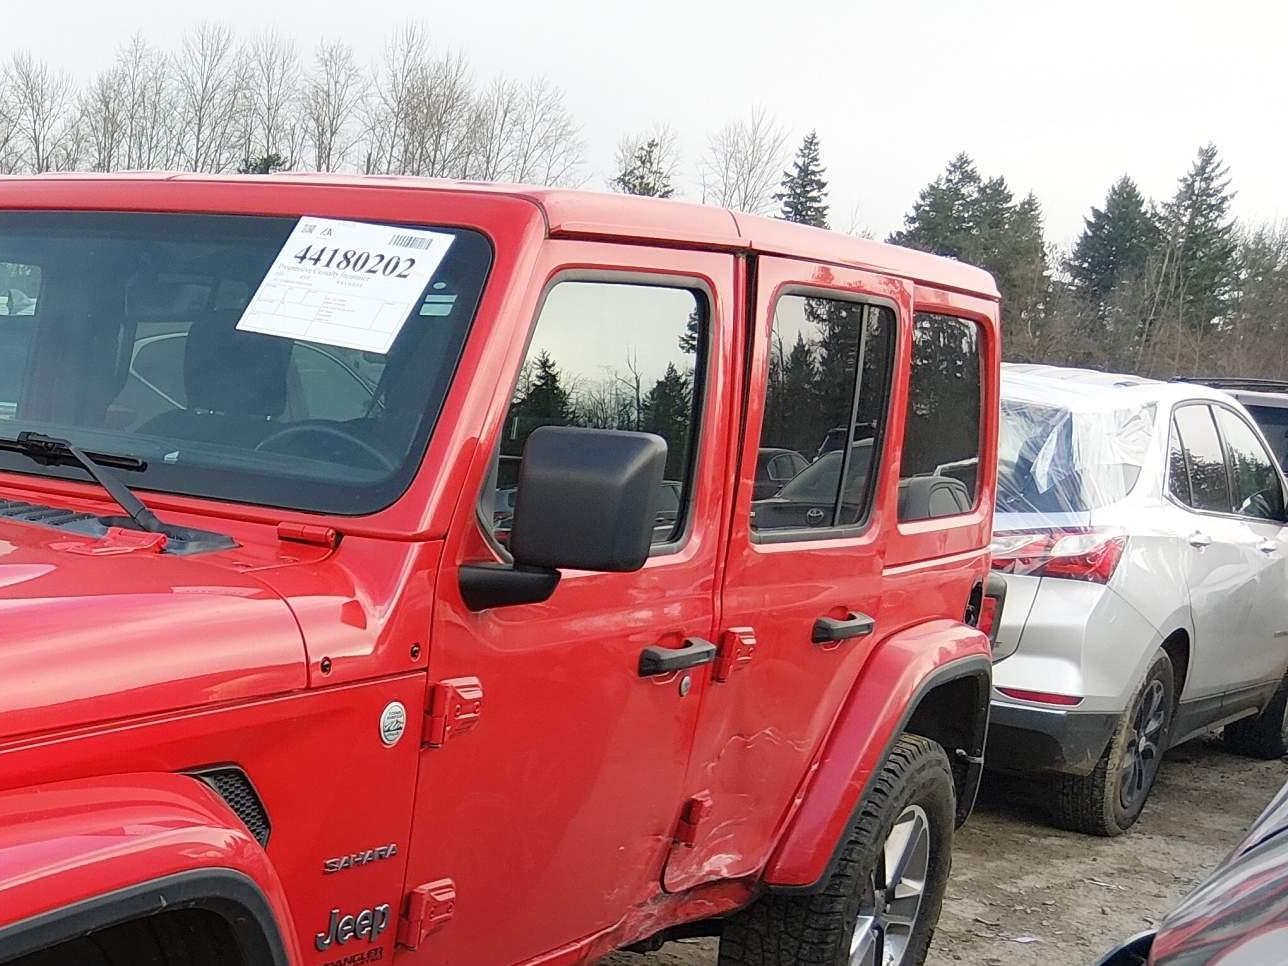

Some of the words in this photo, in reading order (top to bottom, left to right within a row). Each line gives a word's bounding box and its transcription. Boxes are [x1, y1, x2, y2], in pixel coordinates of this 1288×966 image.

[294, 244, 416, 279] 44180202
[323, 843, 397, 872] SAHARA
[316, 903, 389, 951] Jeep
